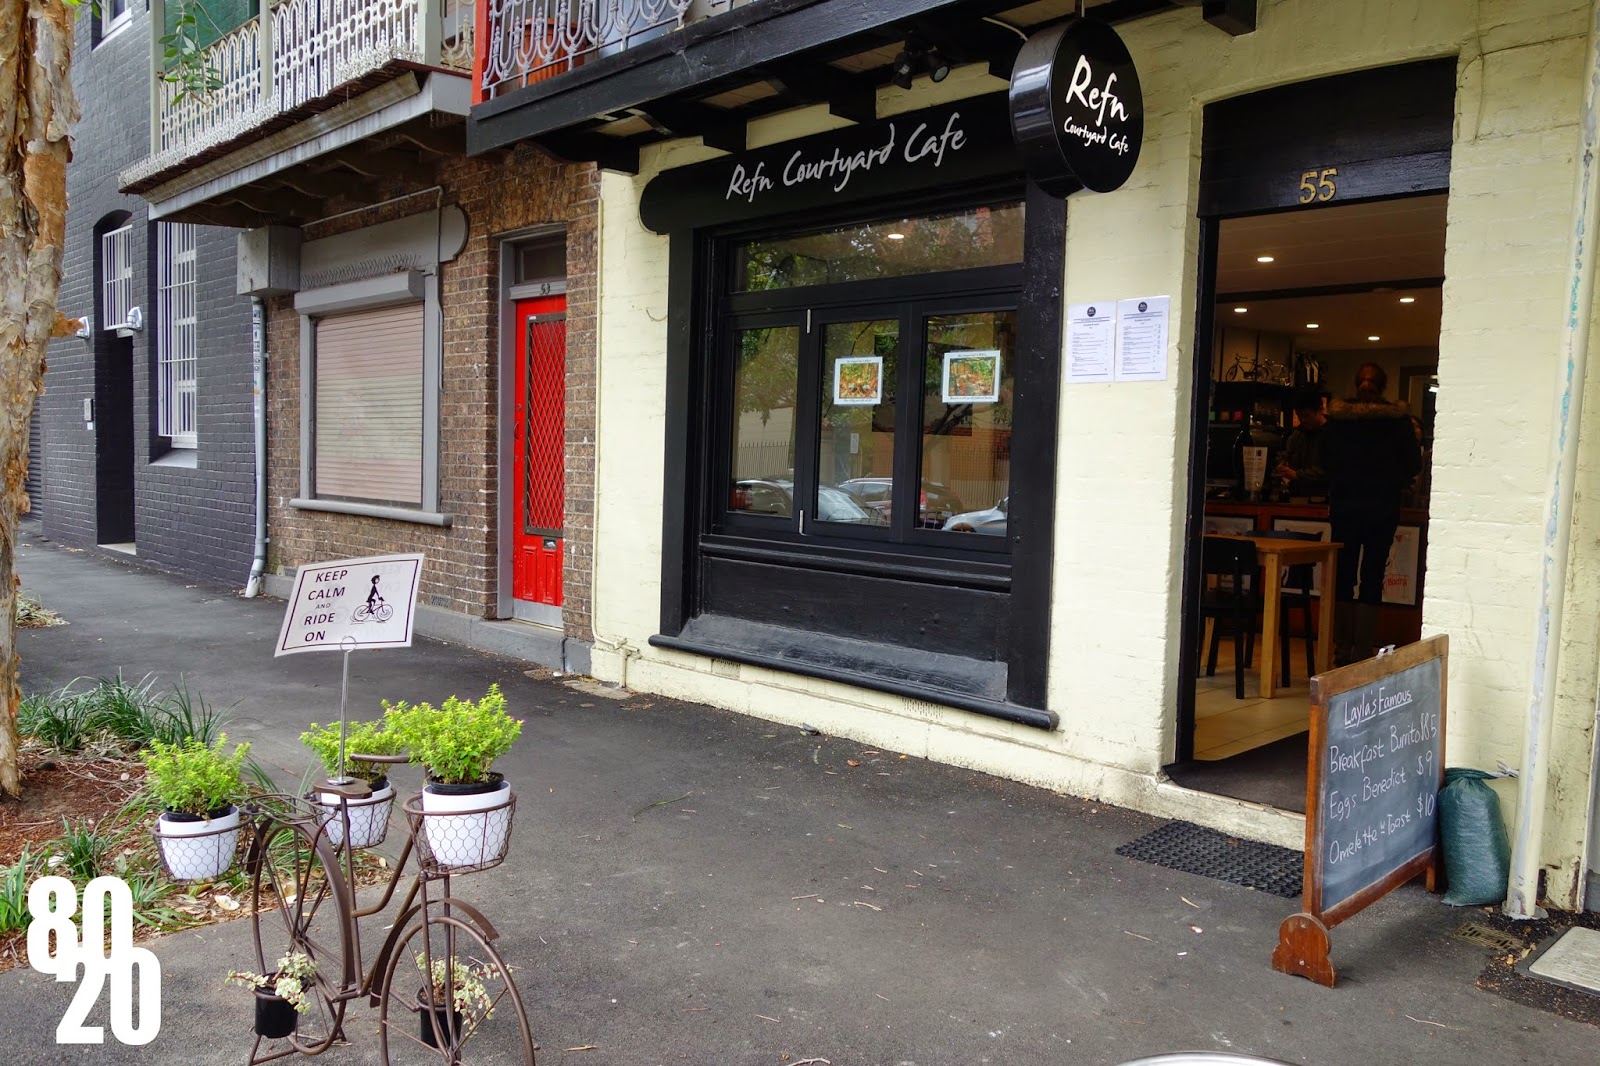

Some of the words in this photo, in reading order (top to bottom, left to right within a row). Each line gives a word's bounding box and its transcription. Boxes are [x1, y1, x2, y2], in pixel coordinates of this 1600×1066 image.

[1066, 54, 1130, 127] Refn
[1063, 116, 1108, 147] Courtyard
[1108, 132, 1130, 156] Cafe
[726, 160, 776, 203] Refn
[782, 122, 897, 192] Courtyard
[903, 111, 968, 167] Cafe
[1298, 167, 1339, 205] 55
[307, 586, 346, 601] CALM
[315, 569, 349, 583] KEEP
[303, 612, 337, 626] RIDE
[315, 602, 332, 610] AND
[304, 630, 327, 643] ON
[1344, 689, 1378, 728] Layla's
[1378, 686, 1412, 713] Famous
[1330, 737, 1385, 774] Breakfast
[1389, 722, 1420, 753] Burrito
[1329, 790, 1357, 822] Eggs
[1362, 766, 1407, 802] Benedict
[1329, 821, 1378, 865] Omelette
[1387, 808, 1411, 836] Toast
[1416, 792, 1435, 819] $10
